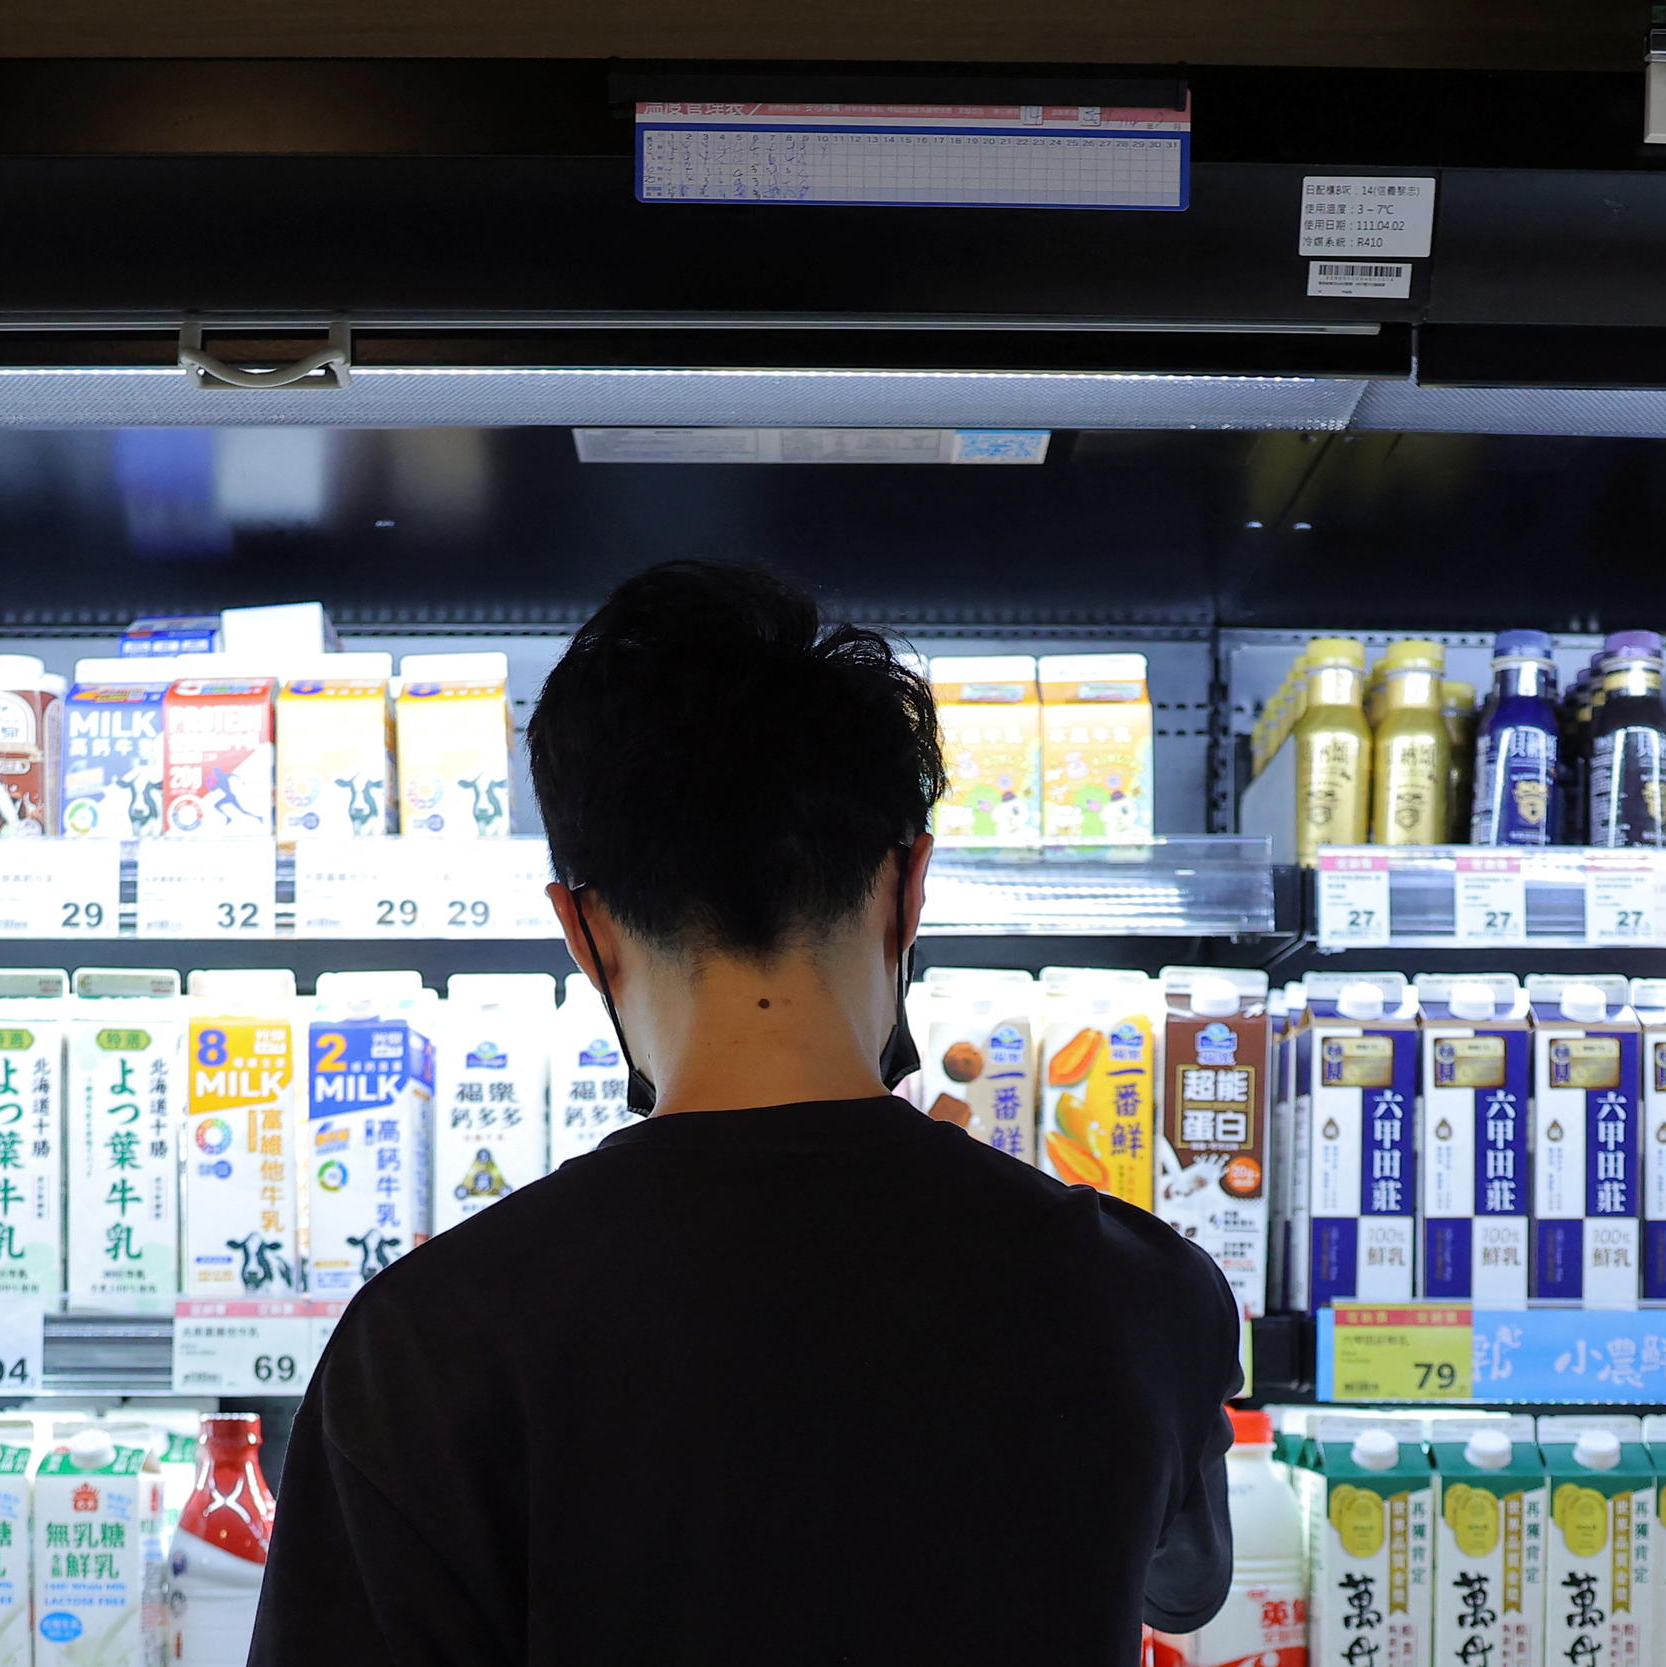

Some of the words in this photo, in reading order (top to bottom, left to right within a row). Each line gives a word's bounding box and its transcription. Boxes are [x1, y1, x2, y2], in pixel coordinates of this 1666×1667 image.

[62, 902, 102, 928] 29
[217, 902, 259, 928] 32
[377, 900, 417, 925] 29
[448, 901, 489, 927] 29
[1348, 911, 1375, 928] 27
[1485, 911, 1512, 928] 27
[1617, 911, 1643, 927] 27
[197, 1029, 228, 1068] 8
[315, 1033, 347, 1072] 2
[1183, 1070, 1249, 1102] 超能
[1183, 1111, 1247, 1142] 蛋白
[104, 1057, 142, 1262] よつ葉牛乳
[1372, 1090, 1403, 1214] 六甲田莊
[1485, 1090, 1517, 1213] 六甲田莊
[254, 1356, 295, 1381] 69
[1414, 1363, 1457, 1390] 79
